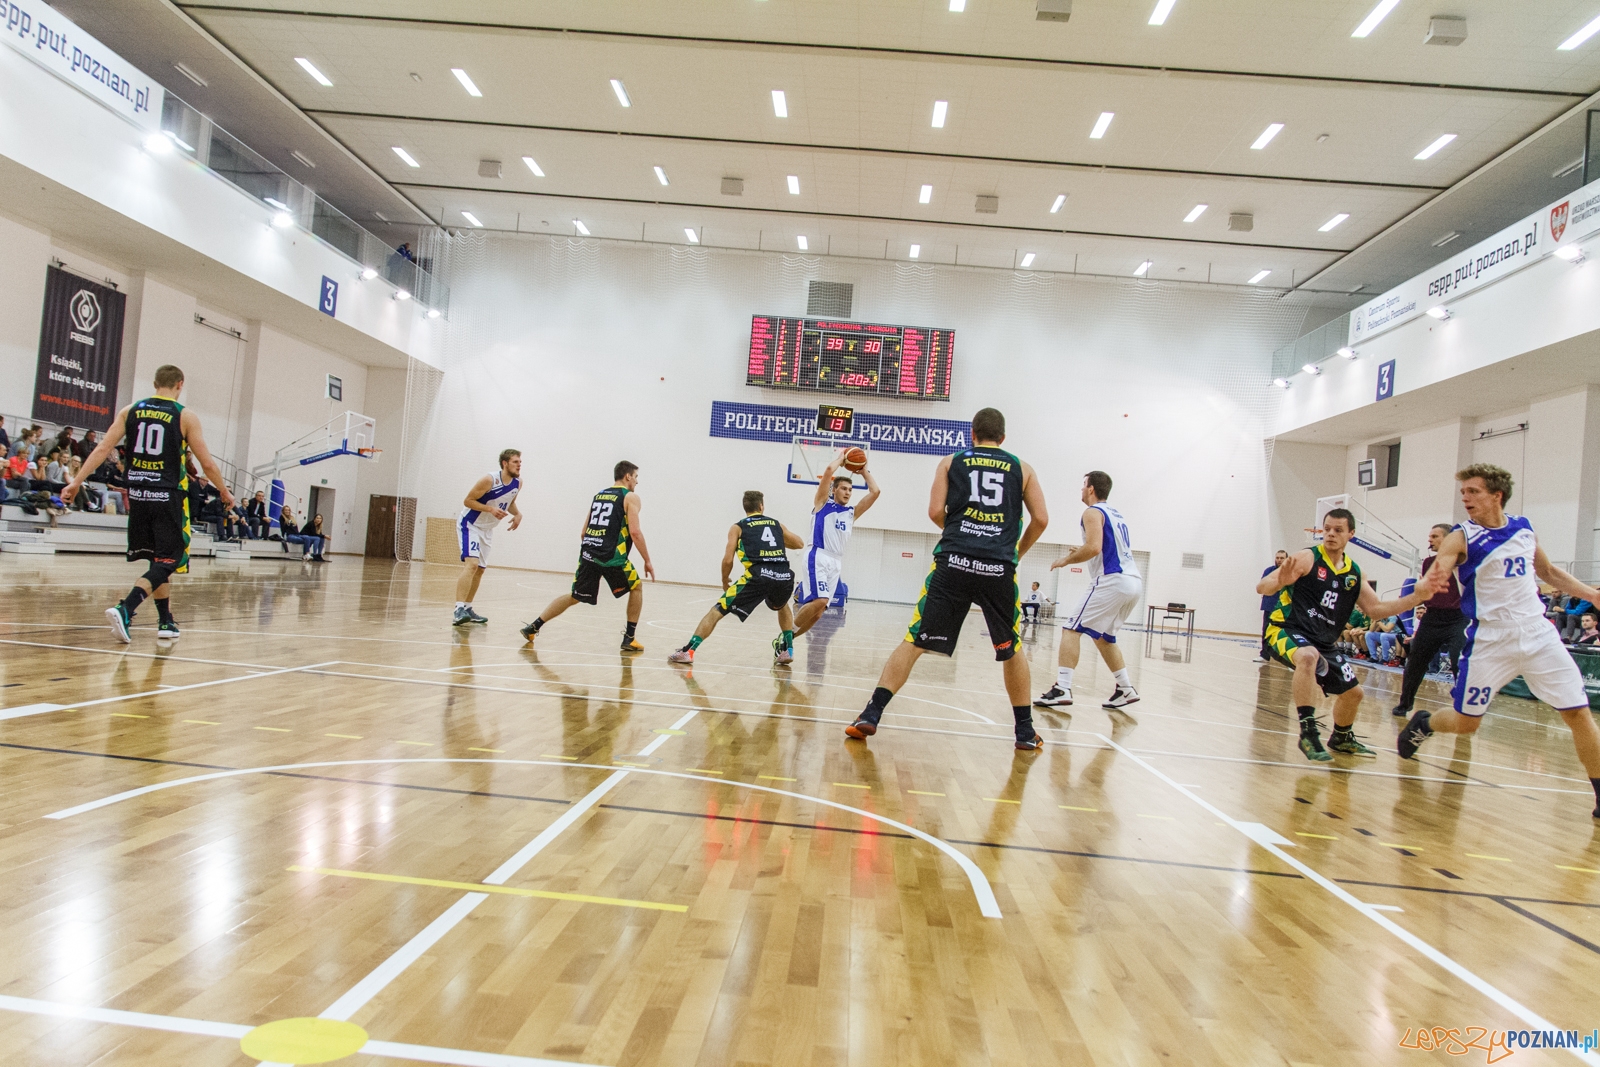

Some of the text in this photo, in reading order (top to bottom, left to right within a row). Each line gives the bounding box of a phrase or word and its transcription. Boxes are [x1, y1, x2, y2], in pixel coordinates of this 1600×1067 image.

[1428, 222, 1537, 297] cspp.put.poznan.pl
[324, 281, 336, 312] 3
[827, 338, 844, 350] 39
[864, 340, 881, 353] 30
[50, 353, 83, 373] Książki,
[49, 369, 107, 393] które się czyta
[1379, 364, 1391, 396] 3
[40, 393, 110, 416] www.rebis.com.pl
[135, 409, 173, 424] TARNOVIA
[830, 418, 844, 431] 13
[133, 421, 165, 456] 10
[858, 422, 967, 448] POZNAŃSKA
[963, 457, 1012, 472] TARNOVIA
[968, 469, 1005, 507] 15
[590, 501, 614, 527] 22
[963, 507, 1005, 523] BASKET
[960, 525, 983, 538] termy
[961, 519, 1003, 532] tarnowskie
[1116, 521, 1131, 549] 10
[760, 526, 778, 547] 4
[948, 553, 1005, 572] klub fitness
[1503, 556, 1526, 578] 23
[1320, 589, 1339, 610] 82
[1466, 686, 1492, 706] 23
